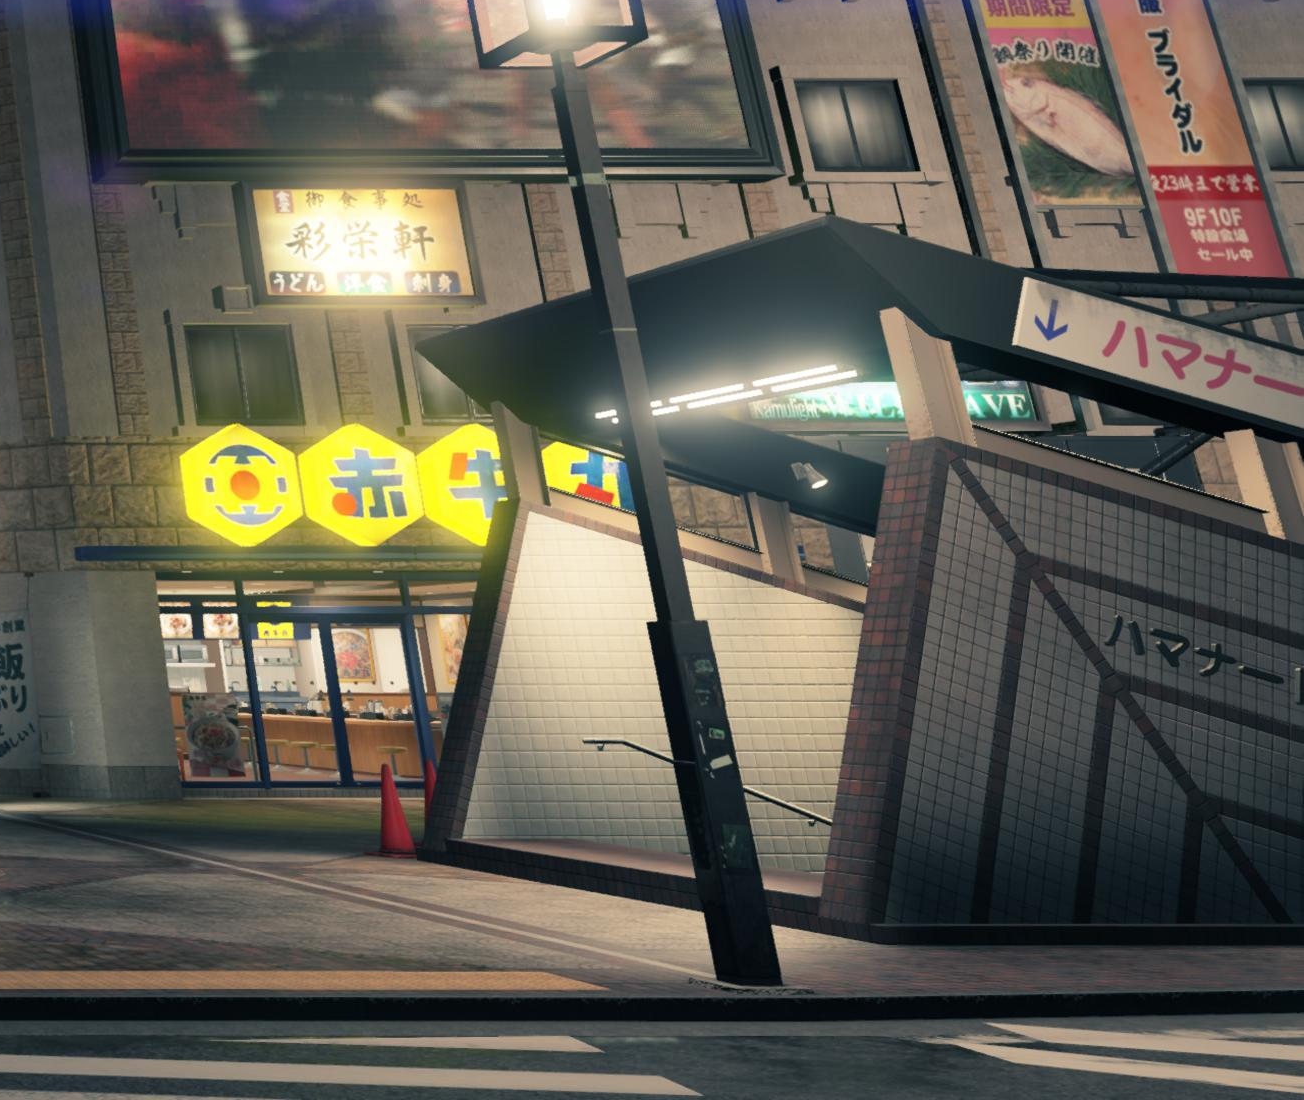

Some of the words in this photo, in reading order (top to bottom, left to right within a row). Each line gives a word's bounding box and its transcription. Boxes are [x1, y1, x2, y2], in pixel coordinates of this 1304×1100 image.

[1147, 27, 1203, 156] ブライダル
[286, 220, 435, 261] 彩栄軒
[272, 272, 324, 293] うどん
